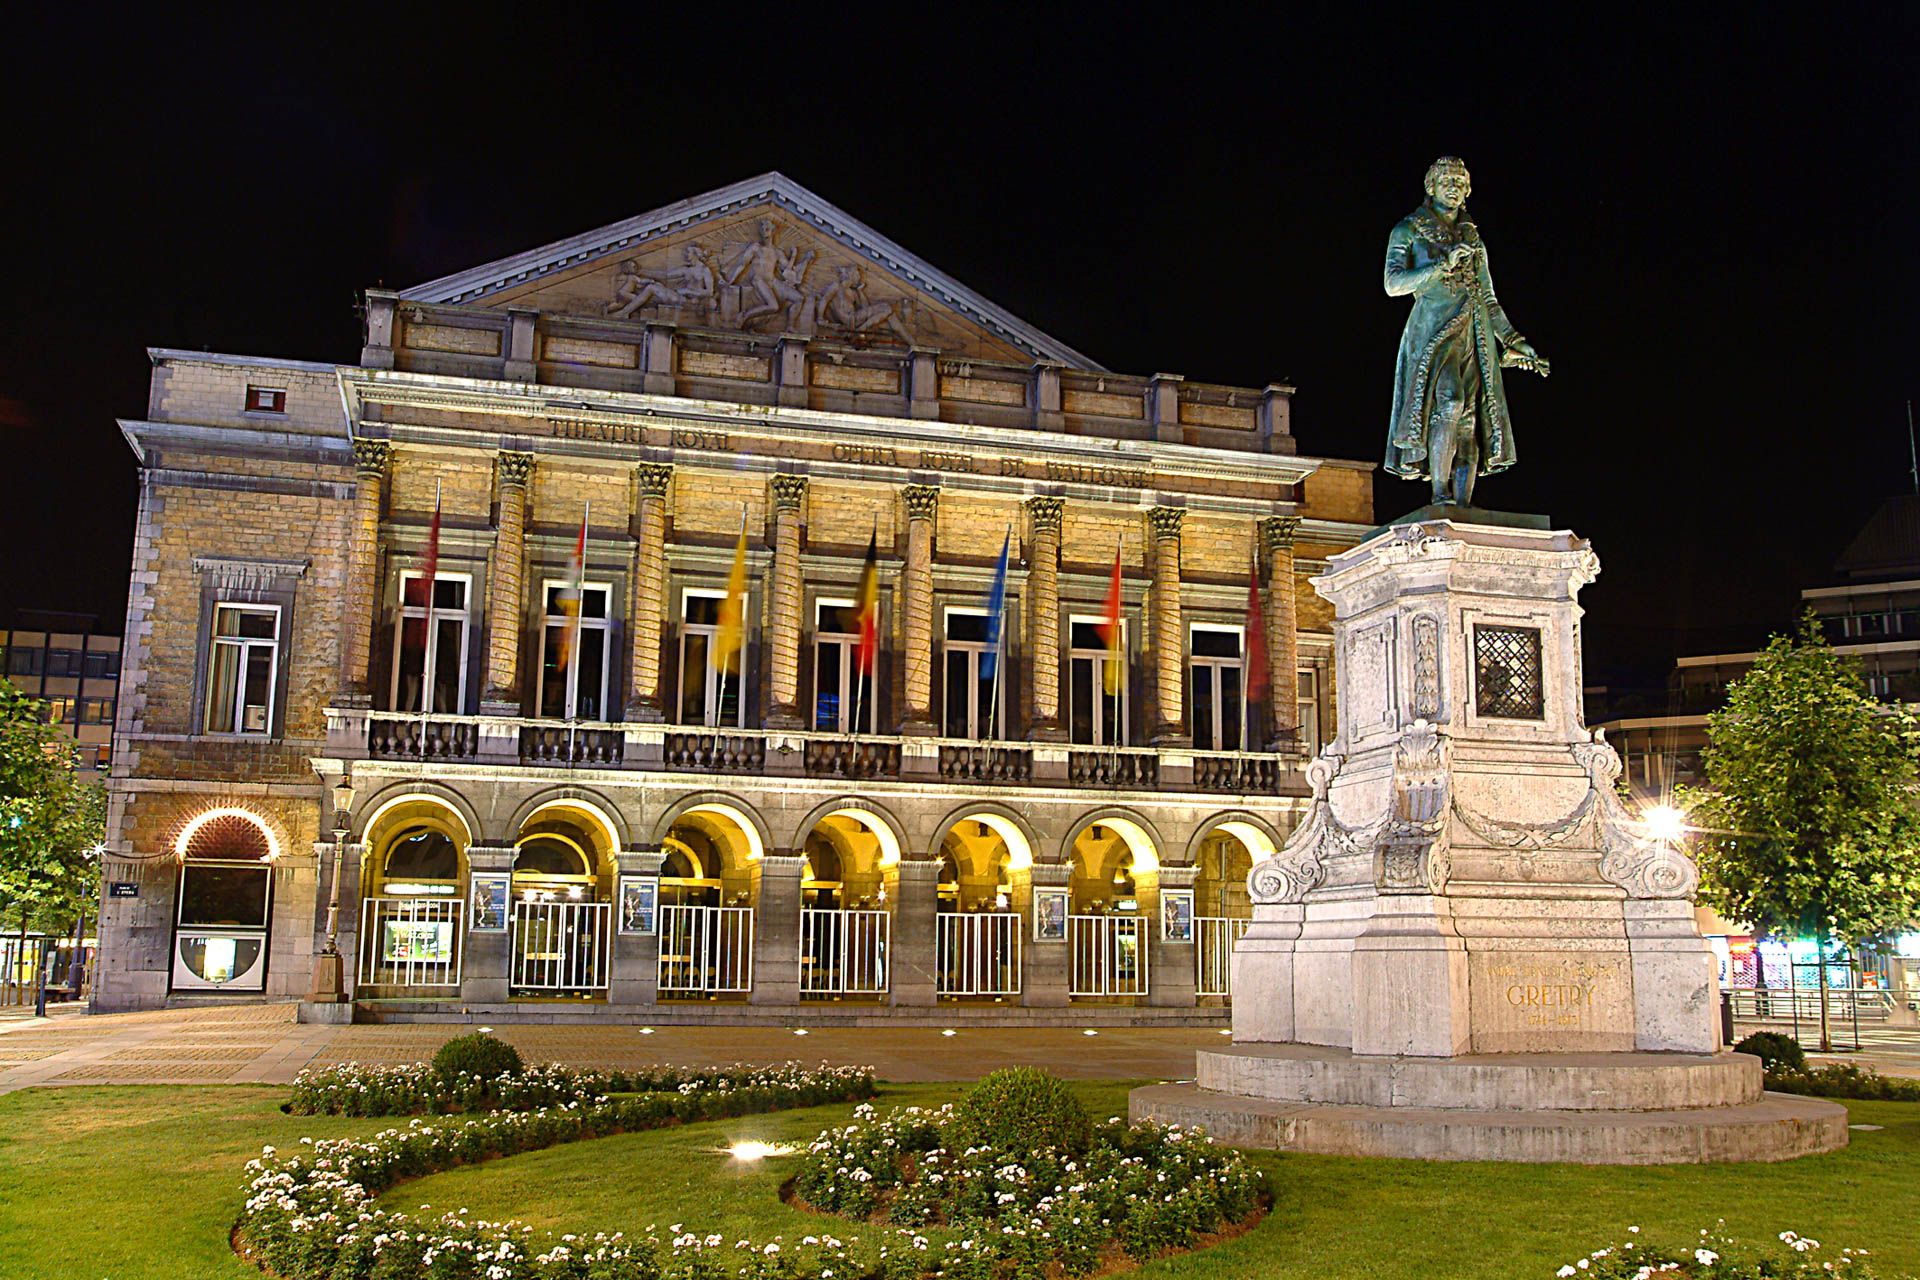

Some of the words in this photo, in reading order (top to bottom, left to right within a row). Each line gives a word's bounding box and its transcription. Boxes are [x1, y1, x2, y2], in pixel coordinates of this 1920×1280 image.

[670, 428, 735, 451] ROYAL
[919, 450, 980, 473] ROYAL
[1000, 457, 1026, 478] DE
[1506, 984, 1597, 1007] GRETRY
